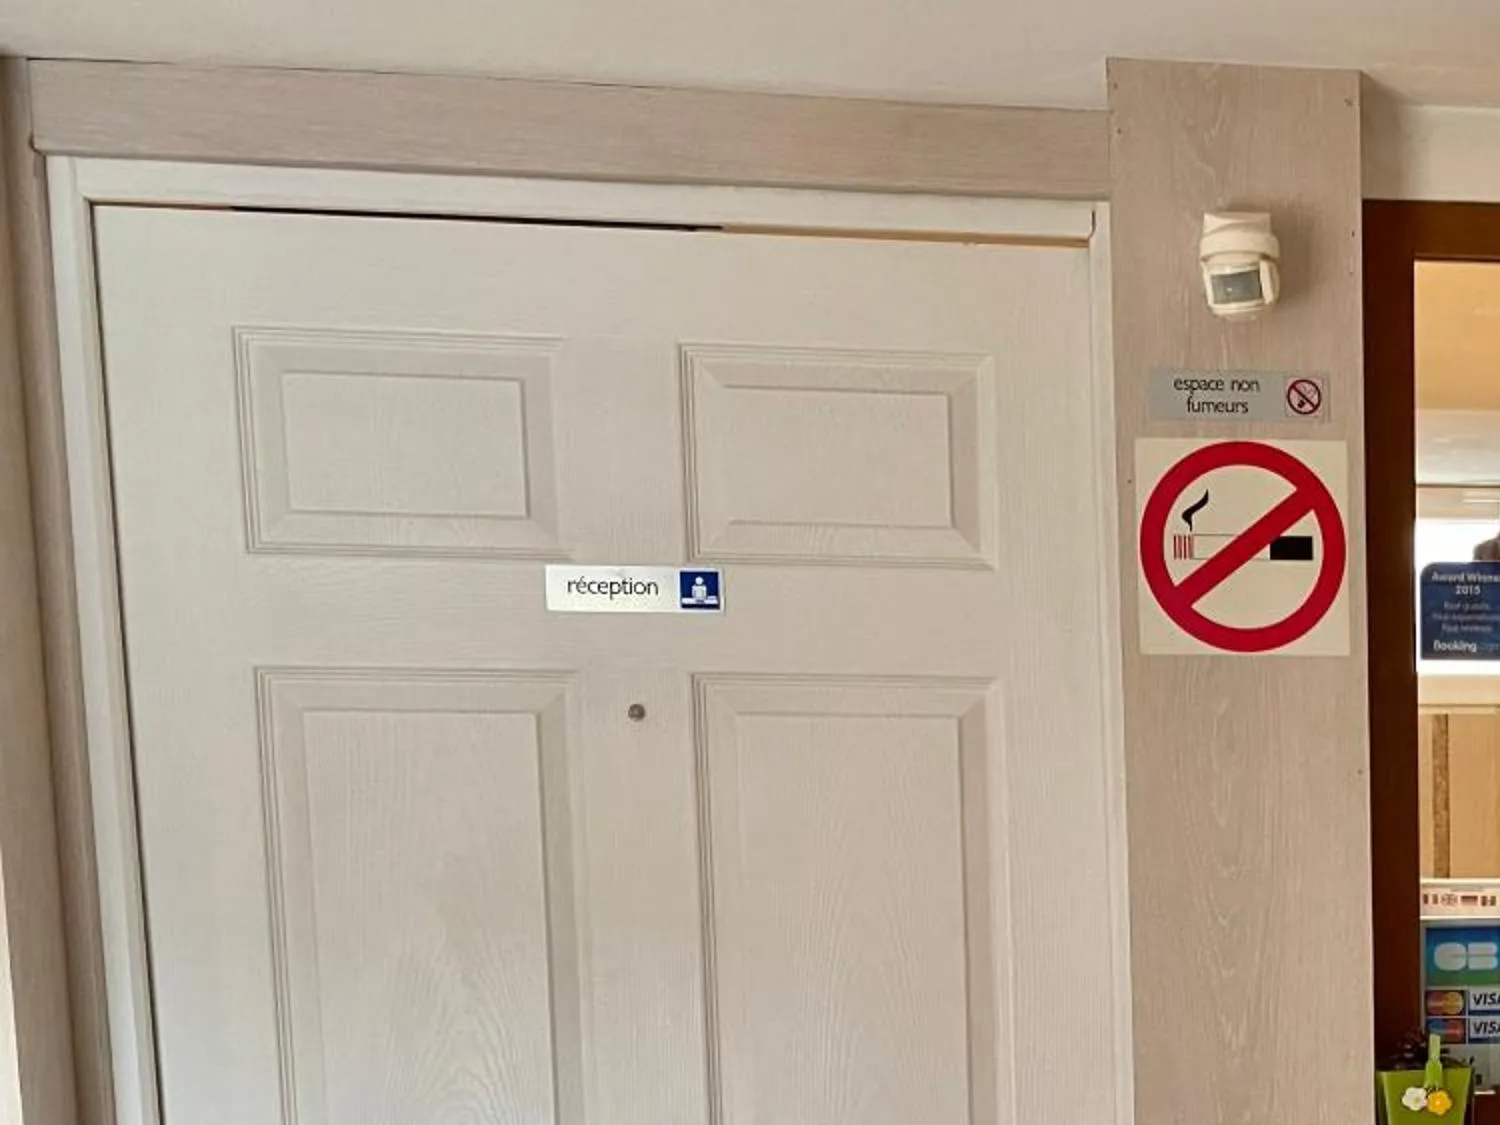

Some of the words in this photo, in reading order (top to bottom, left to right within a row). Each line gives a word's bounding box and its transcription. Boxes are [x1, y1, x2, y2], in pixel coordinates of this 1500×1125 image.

[1173, 377, 1225, 396] espace
[1230, 378, 1260, 392] non
[1187, 395, 1249, 413] fumeurs
[1431, 571, 1465, 582] Award
[567, 576, 659, 600] réception
